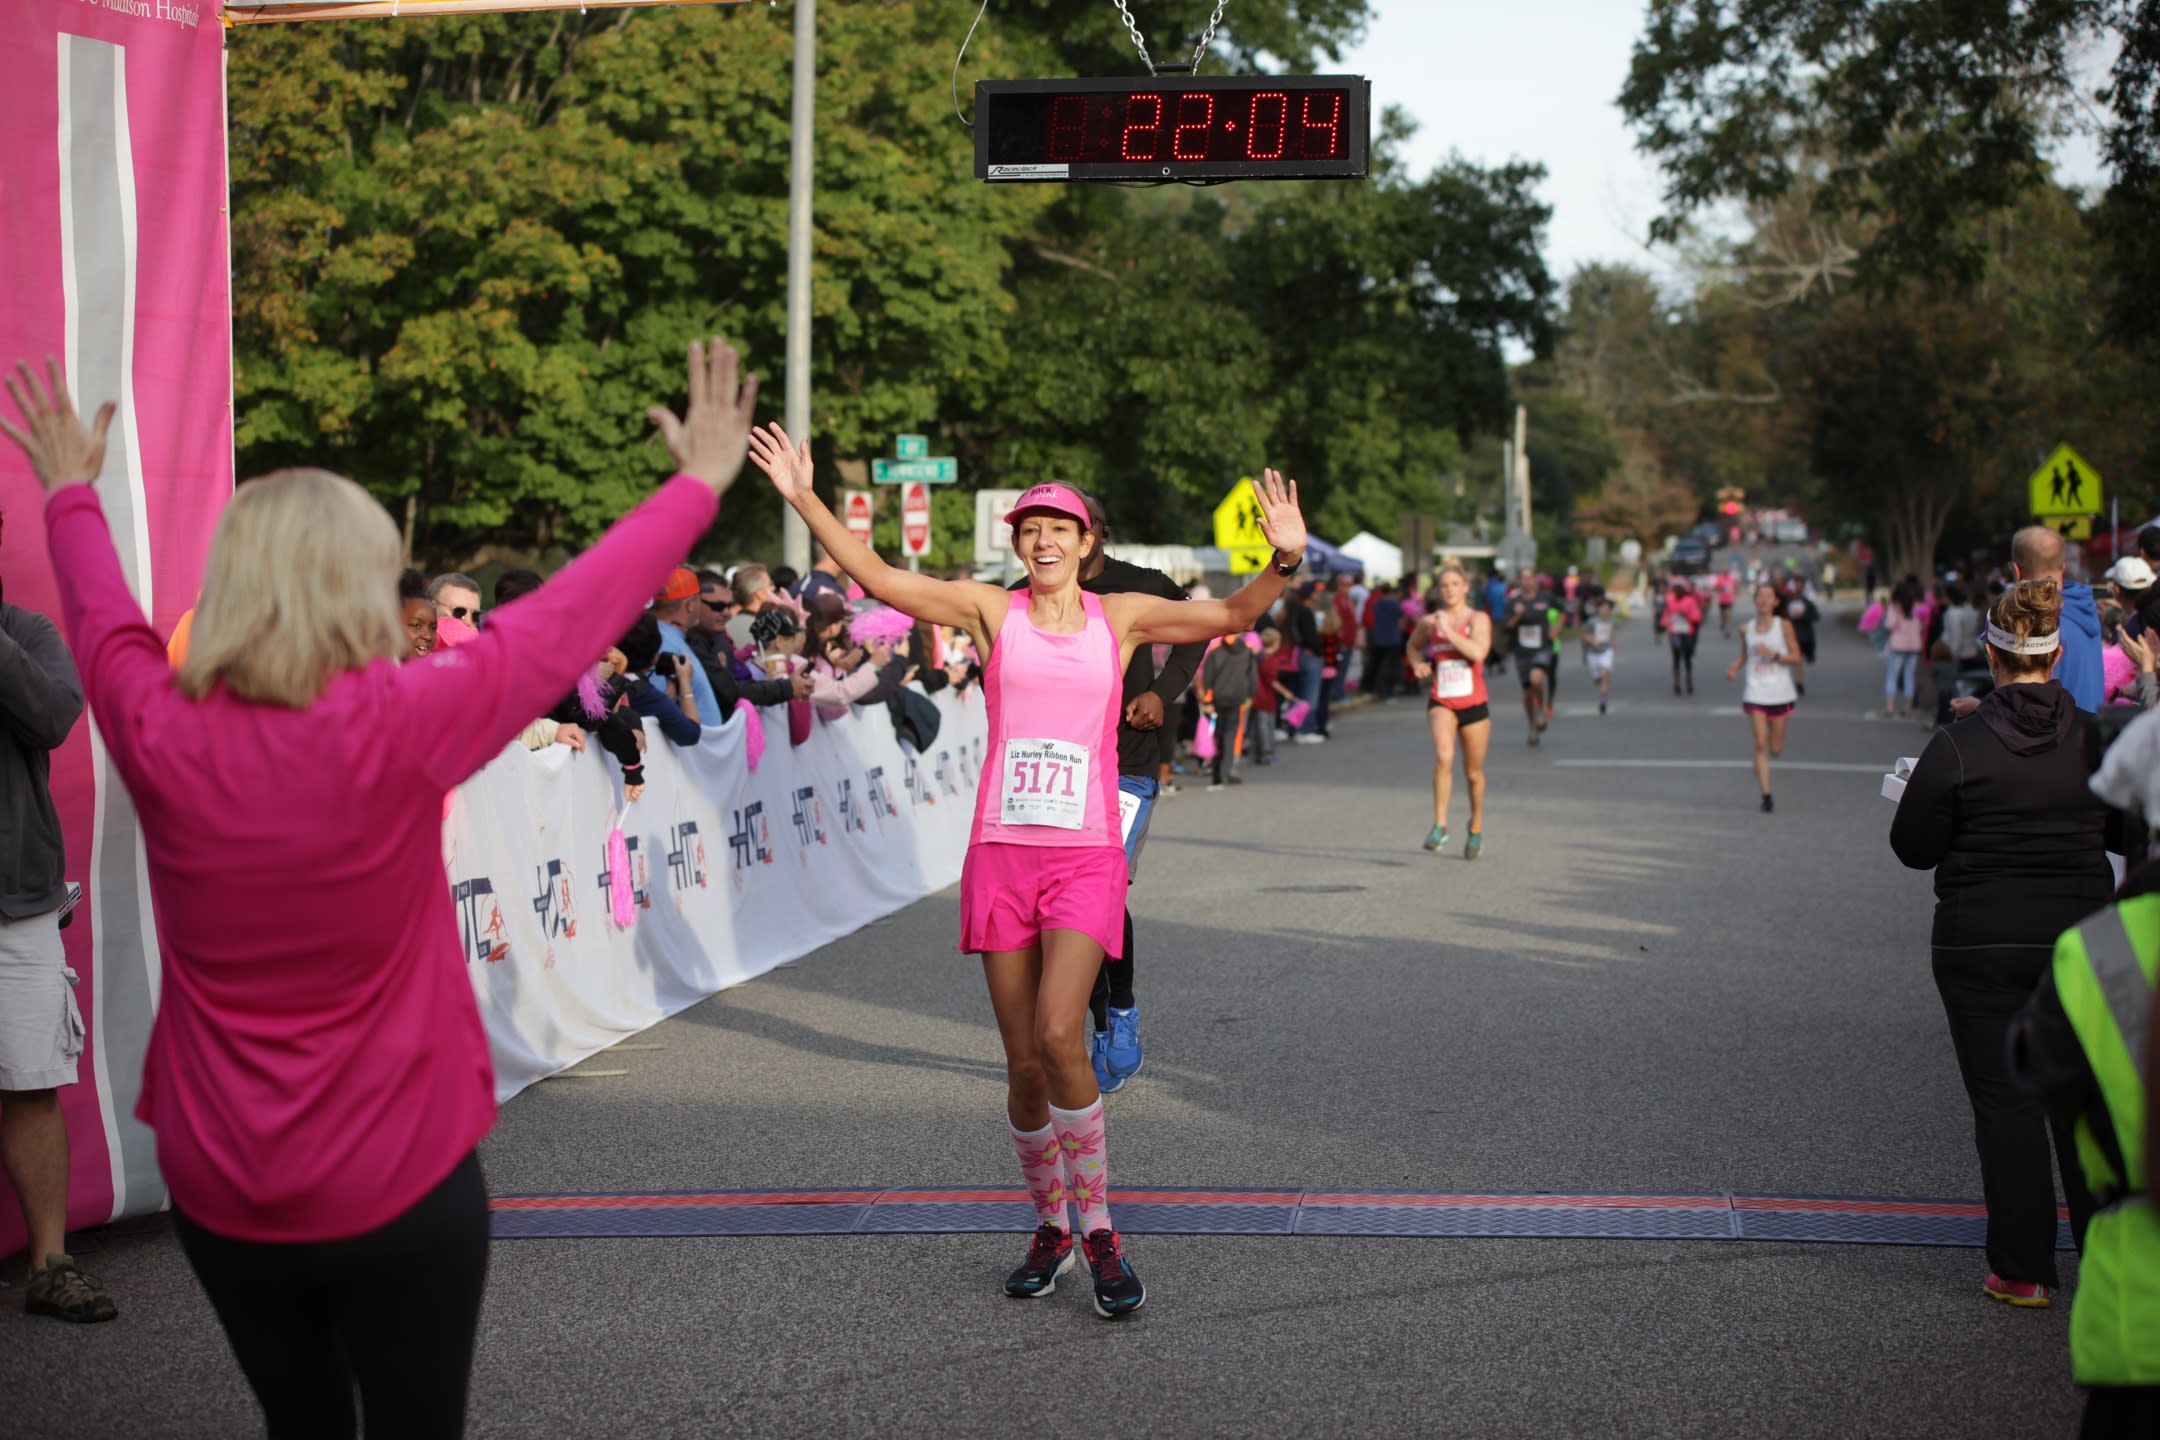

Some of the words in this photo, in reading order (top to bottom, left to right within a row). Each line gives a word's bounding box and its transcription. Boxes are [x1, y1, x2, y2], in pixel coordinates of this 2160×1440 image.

[1011, 750, 1020, 759] Liz
[1021, 750, 1042, 760] Hurley
[1044, 750, 1067, 761] Ribbon
[1069, 754, 1082, 764] Run
[1013, 761, 1075, 797] 5171
